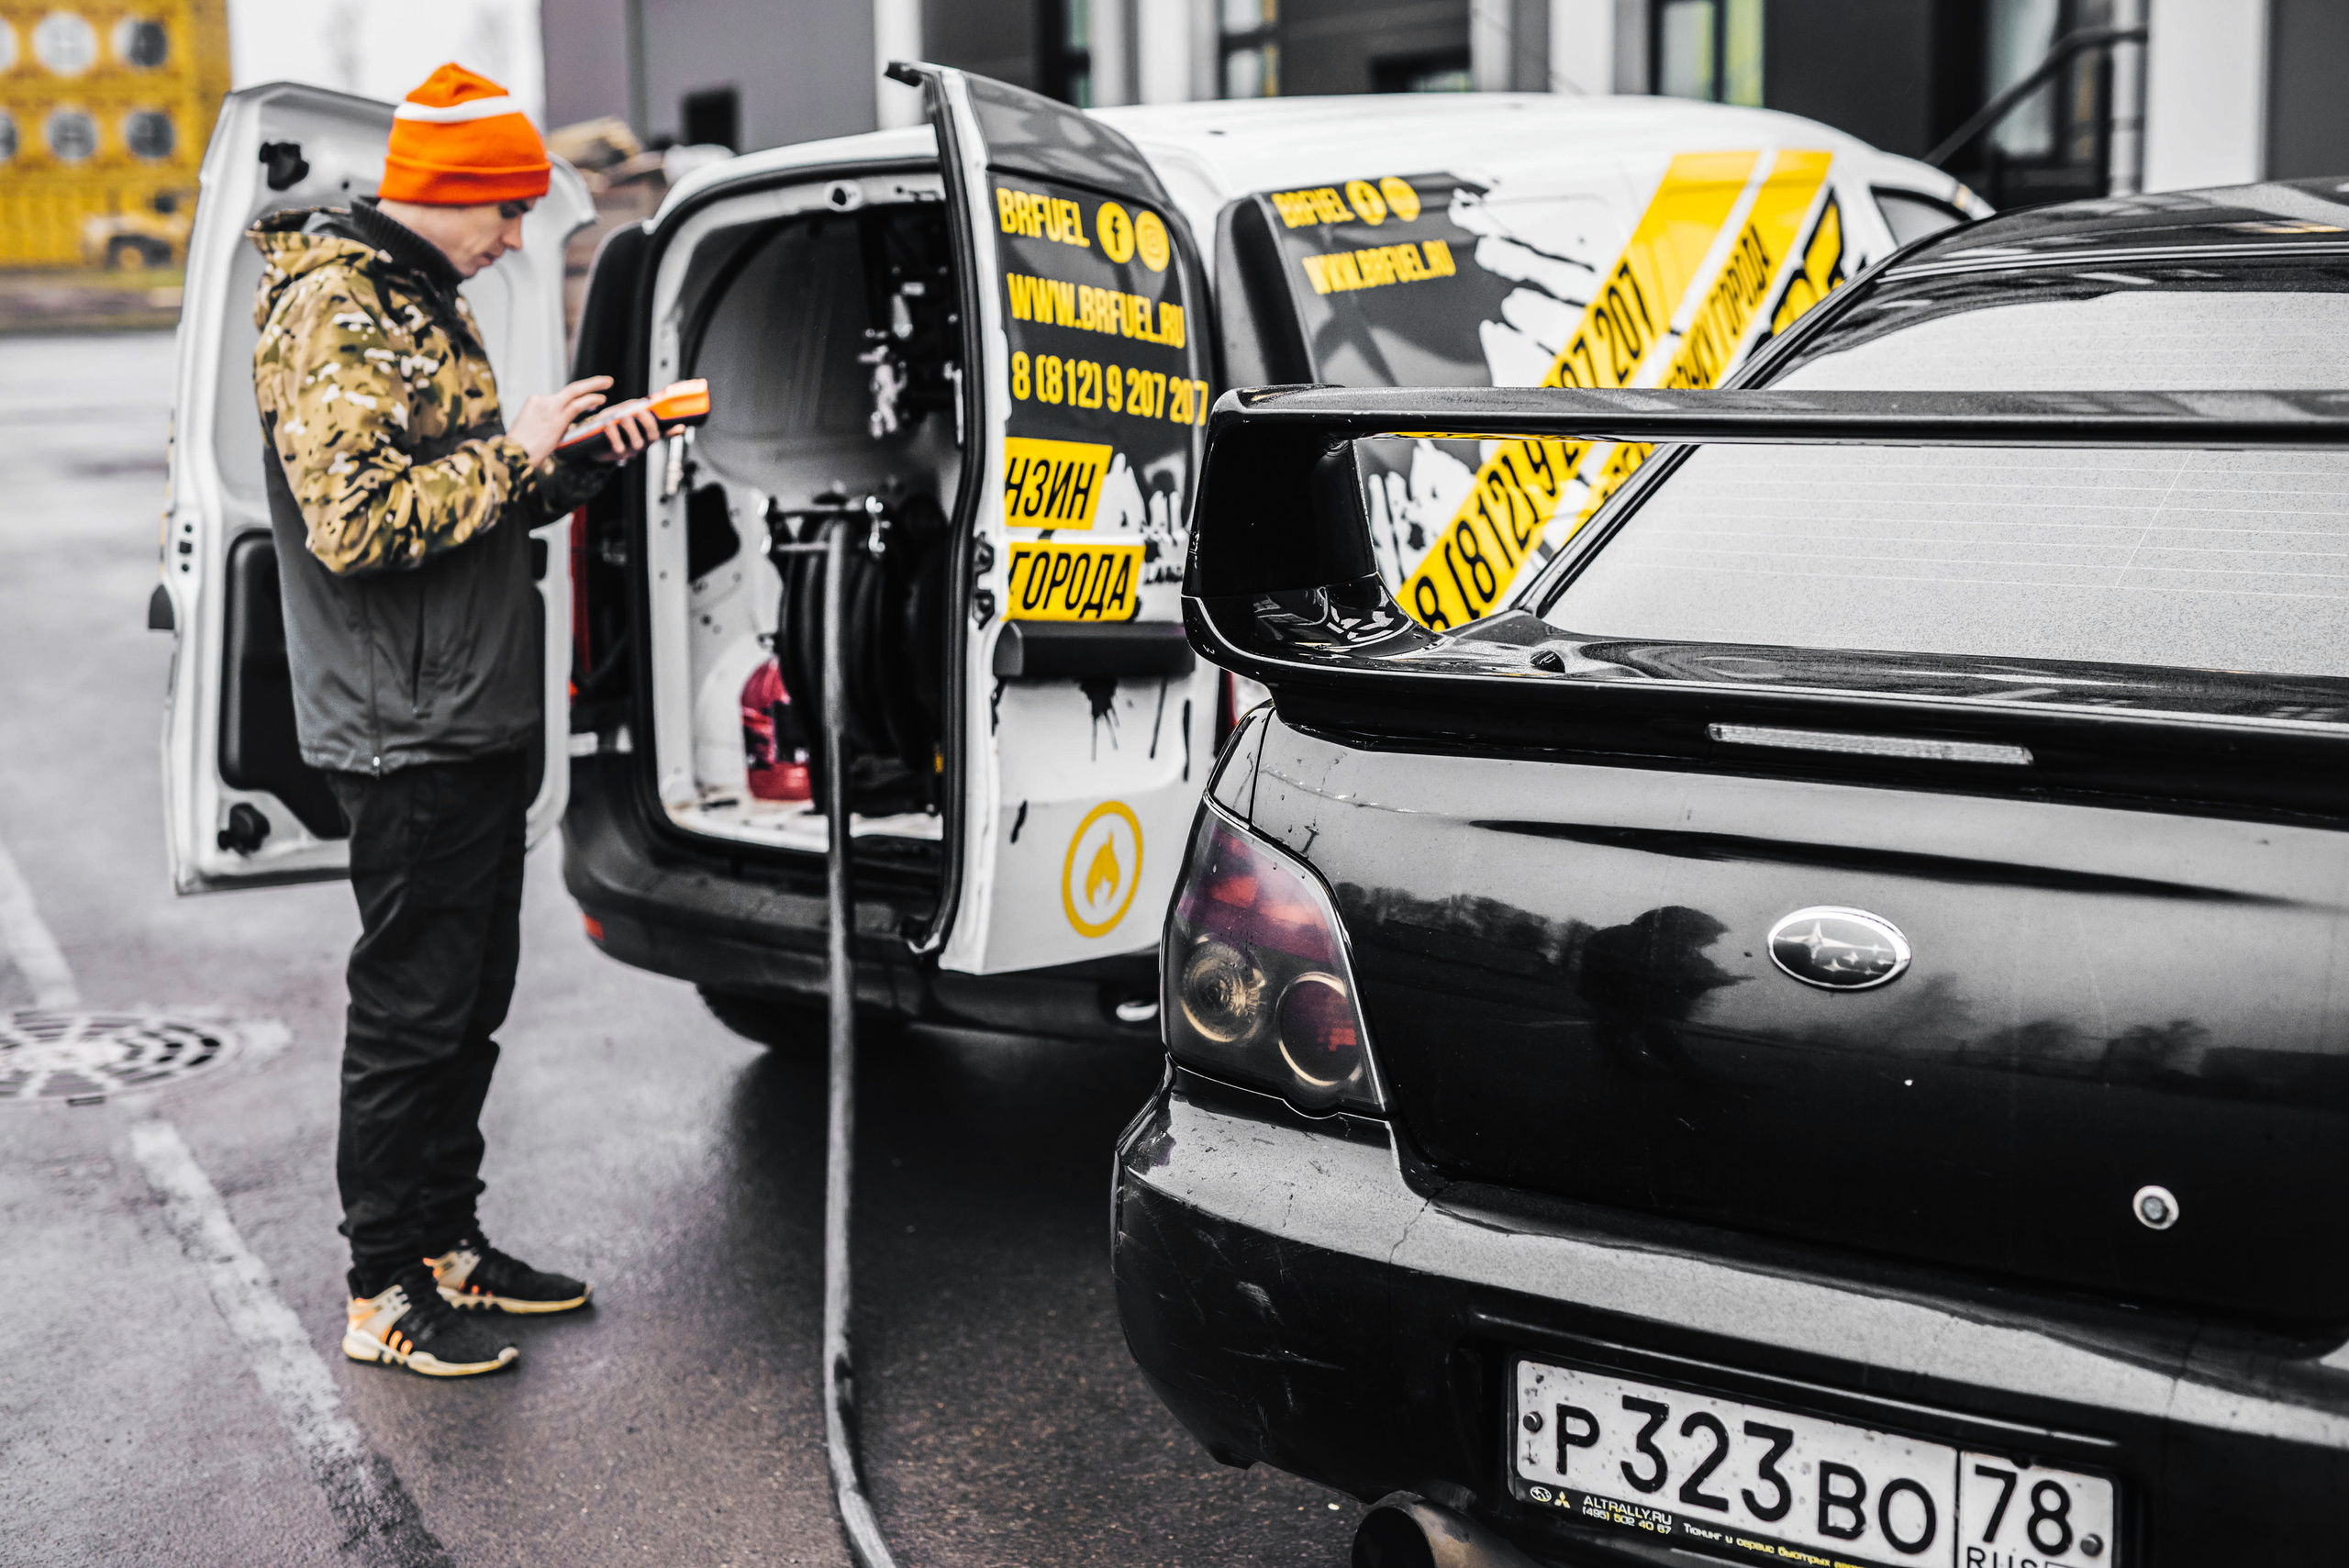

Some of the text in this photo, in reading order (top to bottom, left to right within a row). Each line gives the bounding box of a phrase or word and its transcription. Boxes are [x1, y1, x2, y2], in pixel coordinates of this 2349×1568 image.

[996, 187, 1091, 248] BRFUEL
[1271, 187, 1355, 228] BRFUEL
[1302, 239, 1456, 295] WWW.BRFUEL.RU
[1007, 272, 1186, 349] WWW.BRFUEL.RU
[1011, 350, 1208, 427] 8 (812) 9 207 207
[1008, 550, 1131, 619] ГОРОДА
[1582, 1507, 1610, 1521] (495)
[1613, 1514, 1635, 1527] 502
[1583, 1495, 1672, 1526] ALTRALLY.RU
[1975, 1463, 2074, 1556] 78
